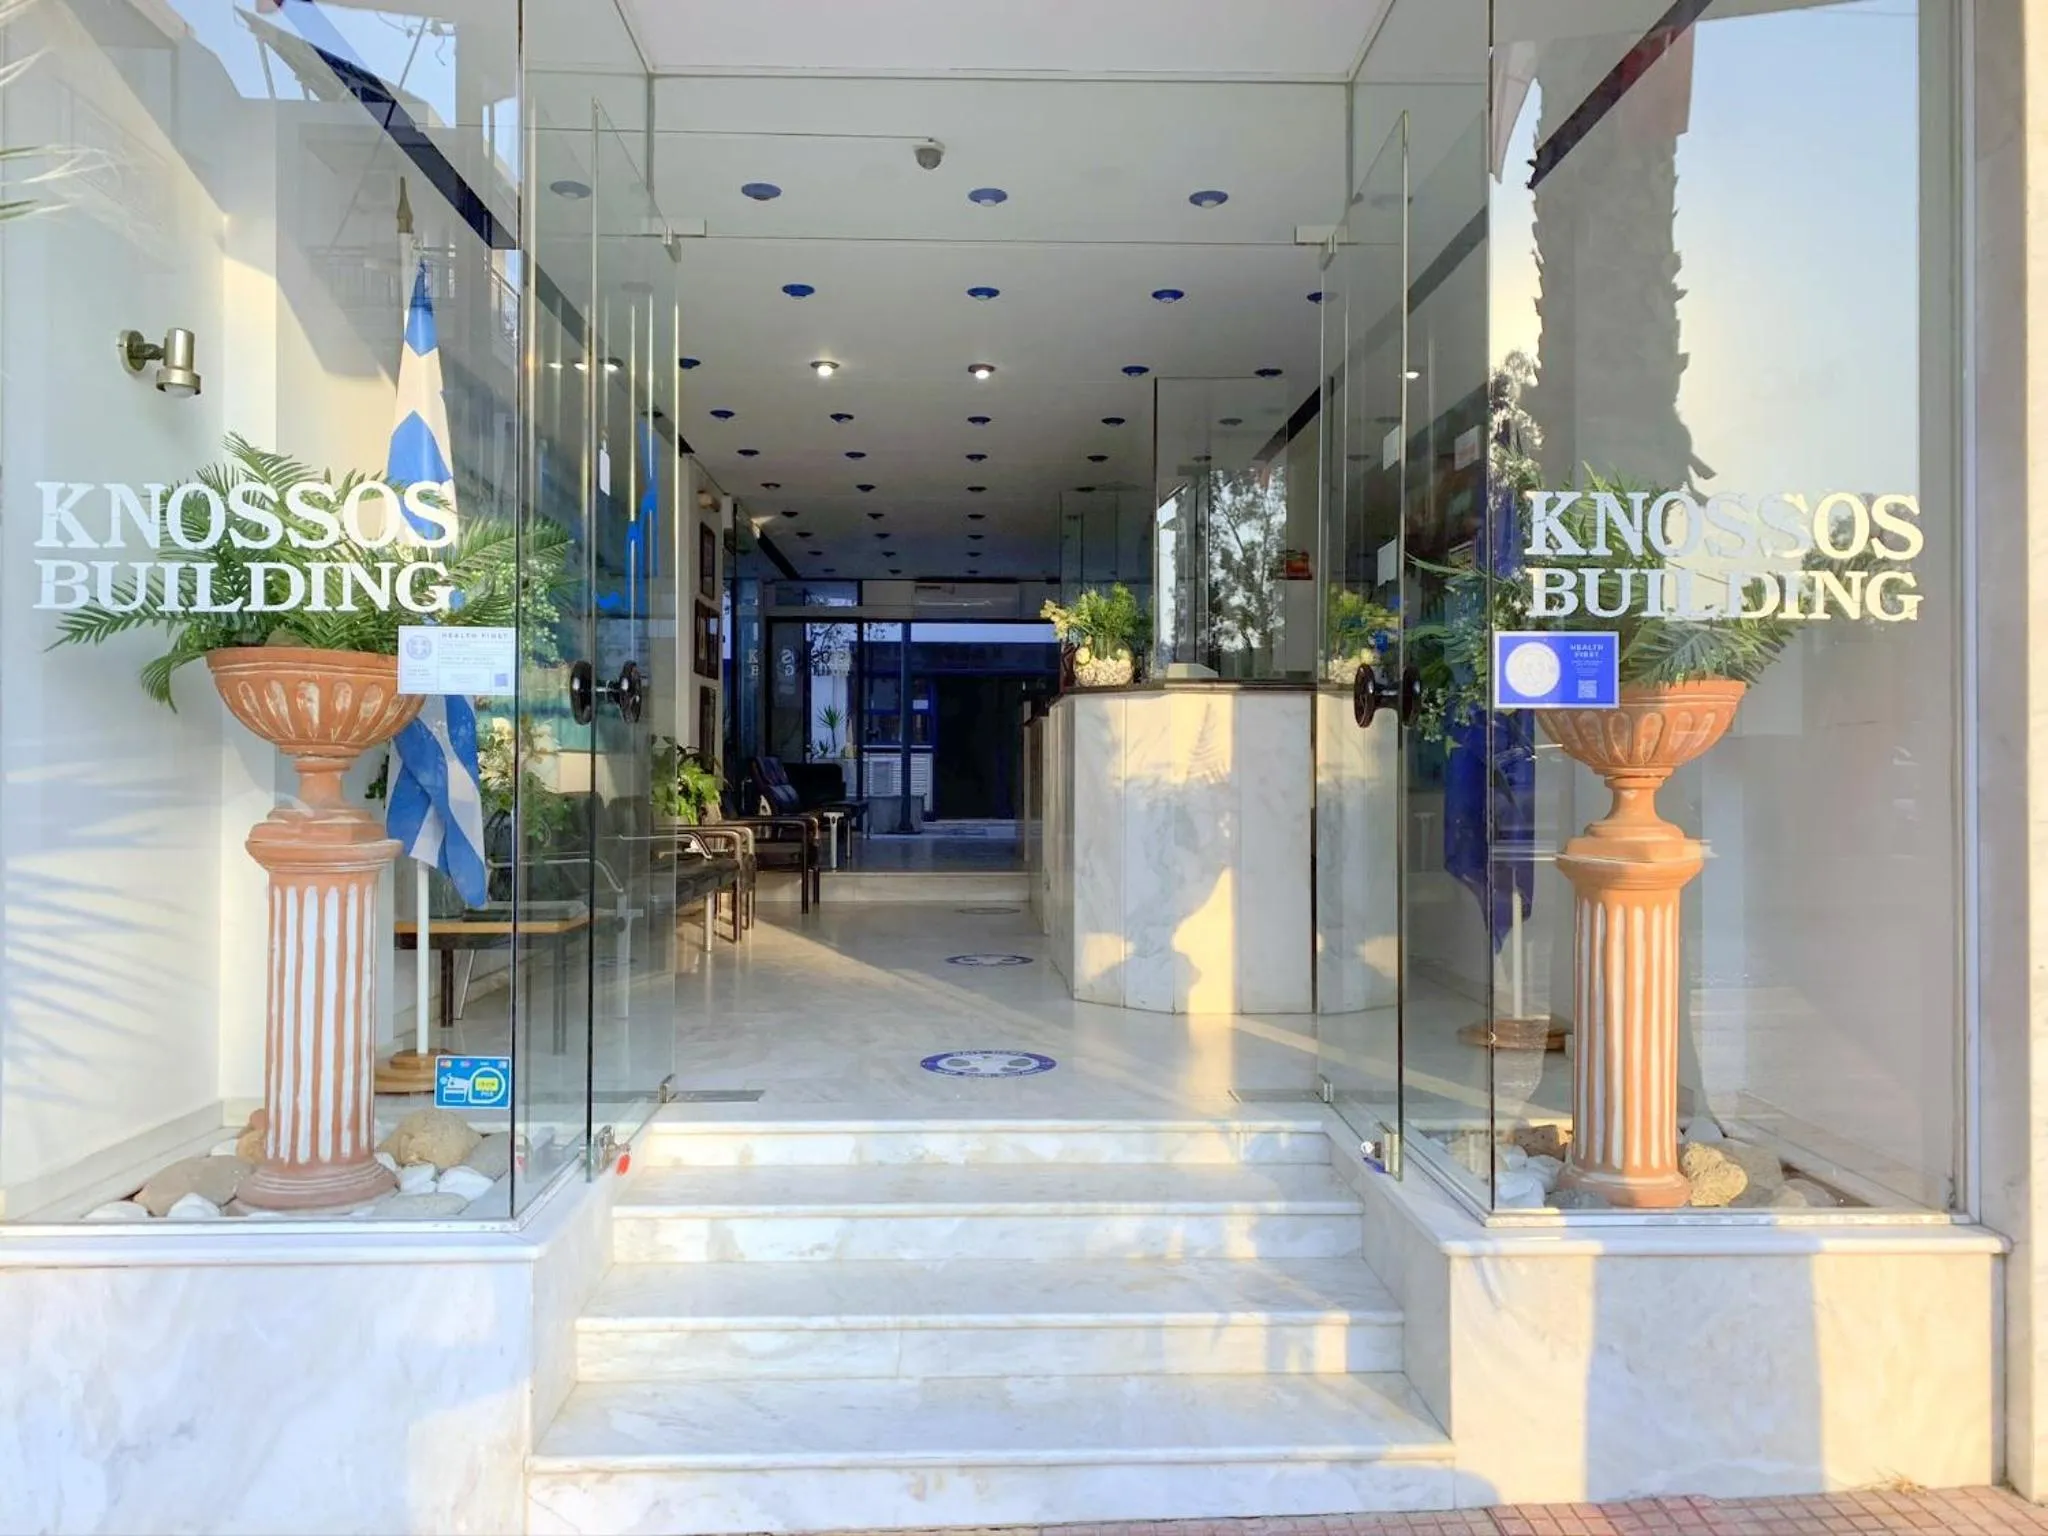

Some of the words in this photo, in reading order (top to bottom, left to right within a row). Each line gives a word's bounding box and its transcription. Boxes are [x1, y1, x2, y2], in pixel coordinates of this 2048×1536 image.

[33, 480, 459, 550] KNOSSOS
[1523, 490, 1925, 561] KNOSSOS
[32, 559, 456, 614] BUILDING
[1524, 567, 1925, 622] BUILDING
[1569, 643, 1604, 651] HEALTH
